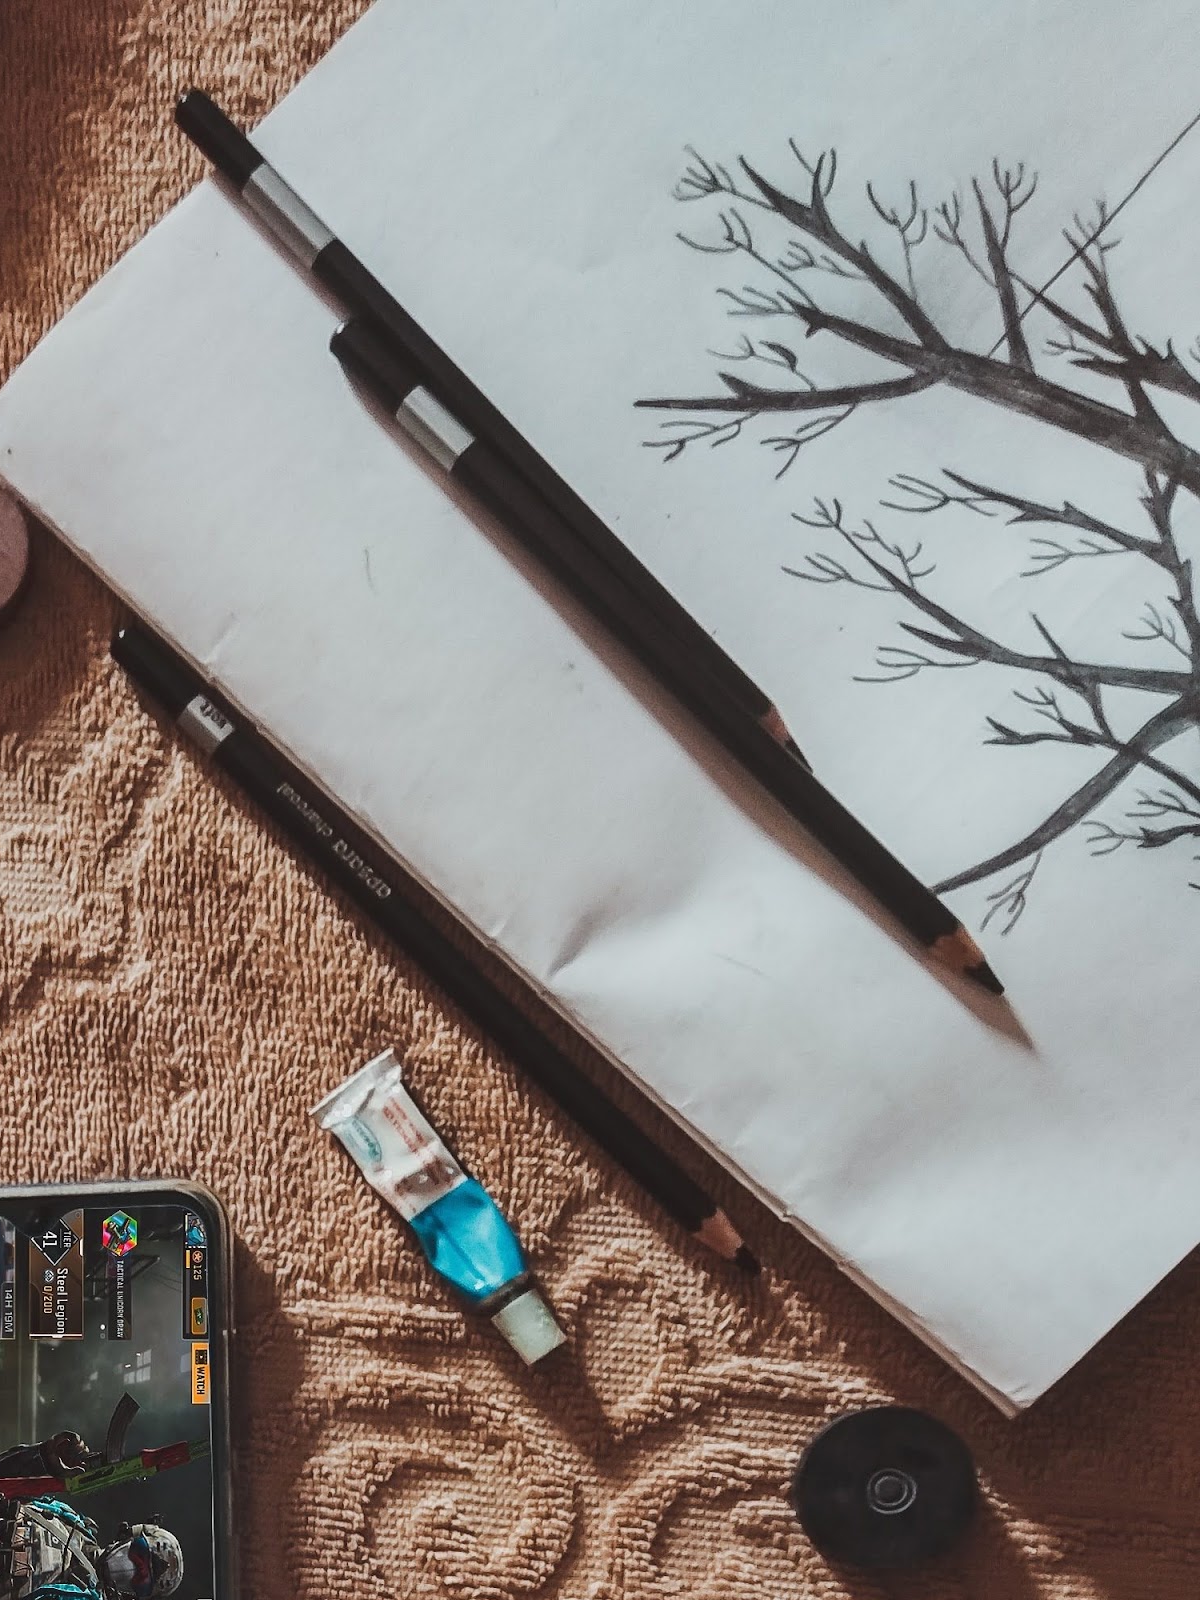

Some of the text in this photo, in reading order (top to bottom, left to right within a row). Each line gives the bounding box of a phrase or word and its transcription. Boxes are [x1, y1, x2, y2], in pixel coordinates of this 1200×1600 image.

[276, 782, 392, 898] apsara charcoal
[42, 1231, 57, 1248] 41
[63, 1231, 72, 1248] TIER
[116, 1260, 124, 1290] TACTICAL
[193, 1264, 202, 1281] 125
[4, 1289, 13, 1333] 14H 19M
[43, 1285, 53, 1314] 0/200
[55, 1268, 69, 1334] Steel Legion
[116, 1291, 124, 1318] UNICORN
[196, 1366, 205, 1395] WATCH
